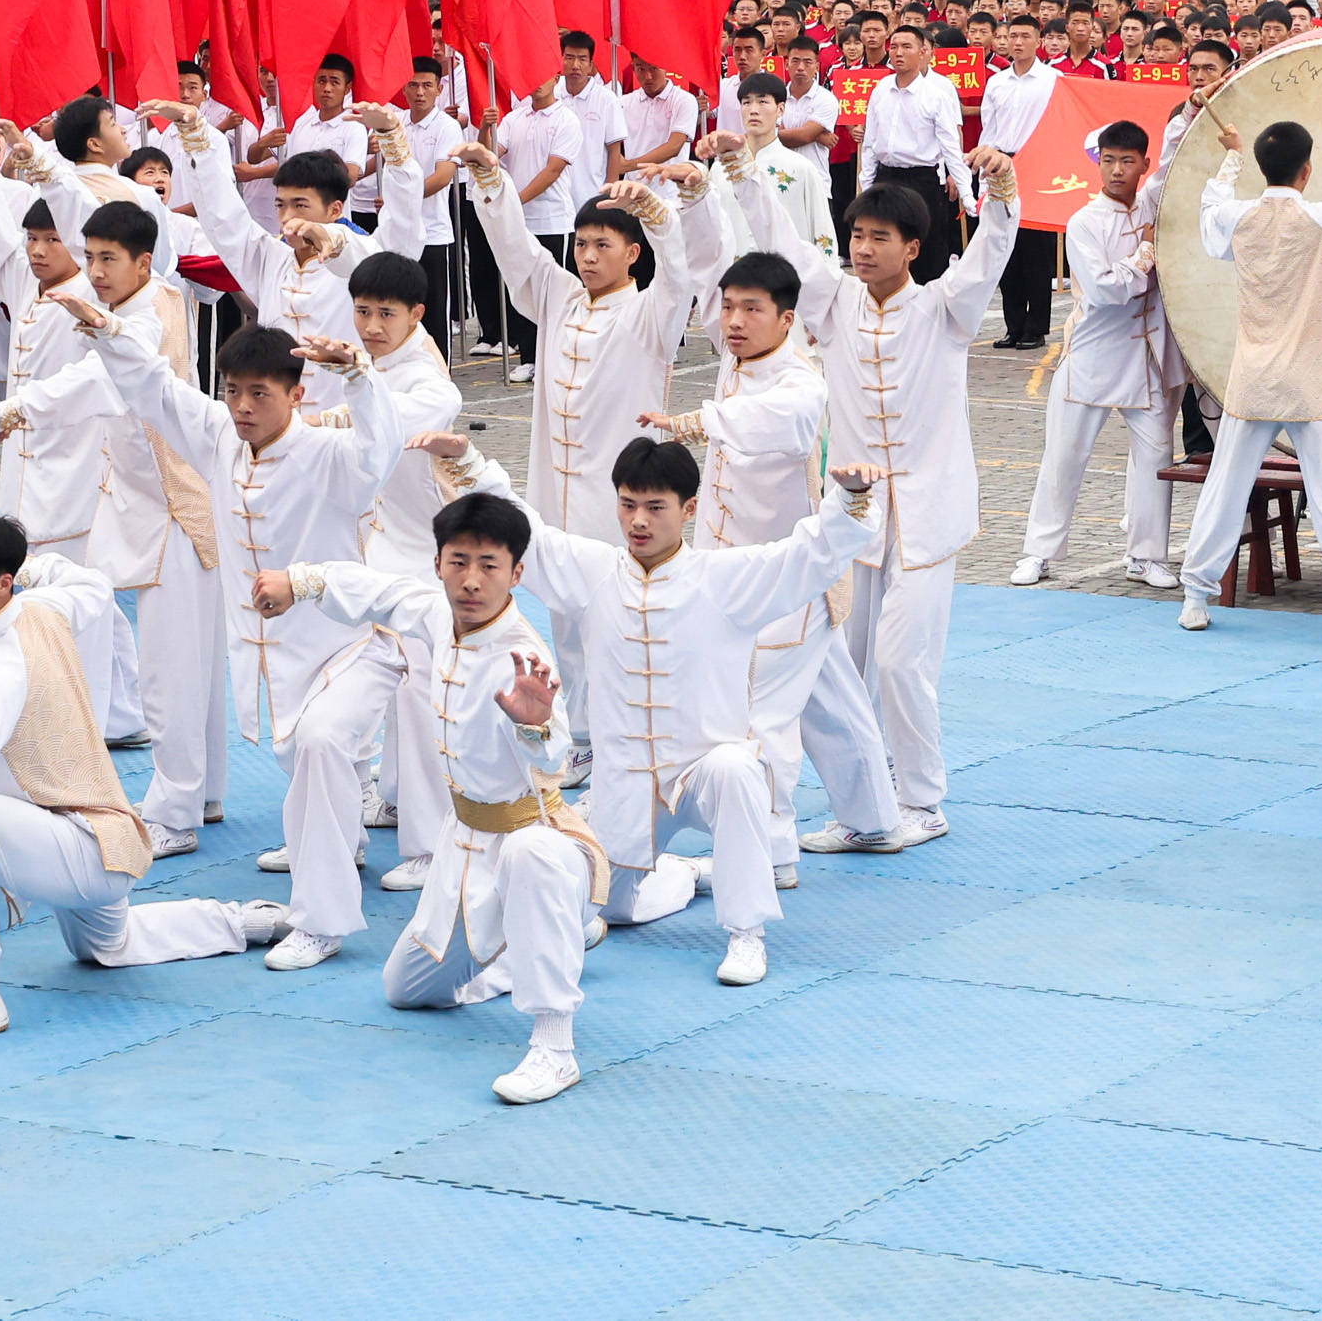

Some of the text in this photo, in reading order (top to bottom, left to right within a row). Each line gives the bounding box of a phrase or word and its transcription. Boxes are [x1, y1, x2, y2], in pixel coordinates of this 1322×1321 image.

[946, 72, 980, 89] 表队
[1132, 67, 1181, 81] 3-9-5
[838, 99, 867, 115] 代表
